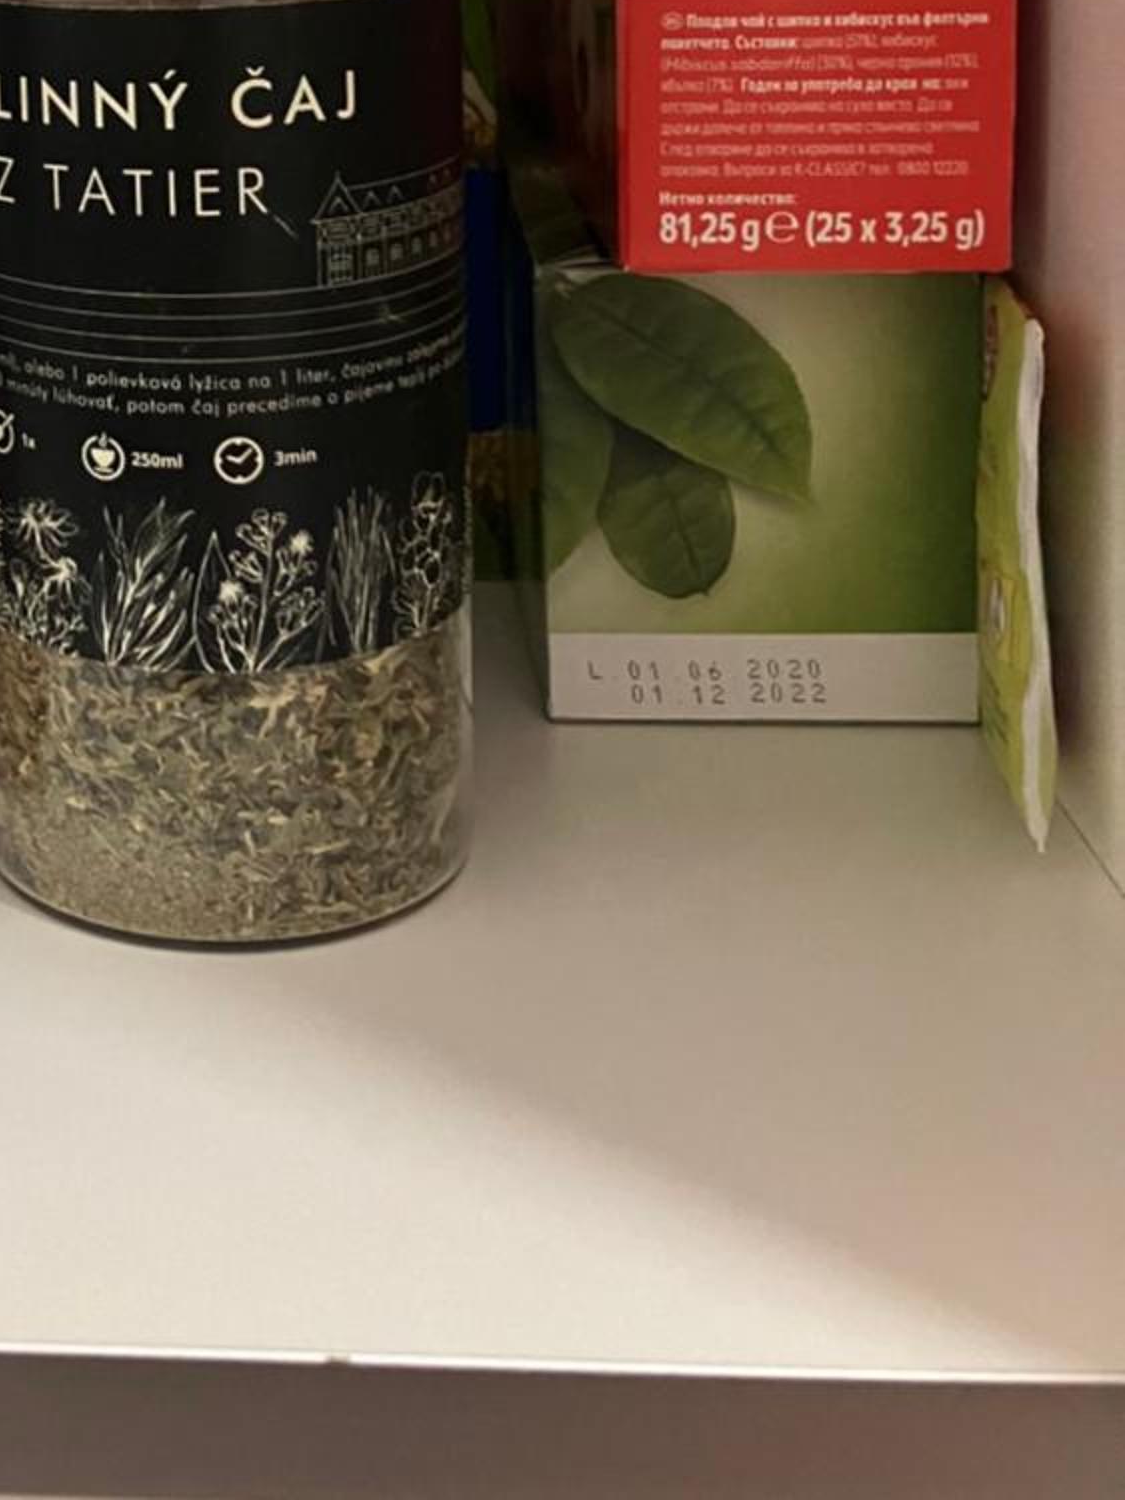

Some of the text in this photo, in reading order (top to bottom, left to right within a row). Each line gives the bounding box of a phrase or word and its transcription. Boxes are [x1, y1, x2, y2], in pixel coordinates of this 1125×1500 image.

[230, 65, 359, 129] ČAJ
[43, 164, 268, 218] TATIER
[804, 209, 853, 248] (25
[859, 217, 877, 243] x
[883, 210, 948, 248] 3,25
[955, 208, 986, 251] g)
[86, 368, 183, 391] polievková
[188, 372, 242, 395] lyžica
[247, 374, 272, 389] na
[126, 398, 185, 416] potom
[191, 398, 220, 419] čaj
[130, 450, 184, 470] 250ml
[273, 447, 318, 467] 3min
[586, 658, 823, 681] L 01 06 2020
[630, 681, 827, 705] 01 12 2022
